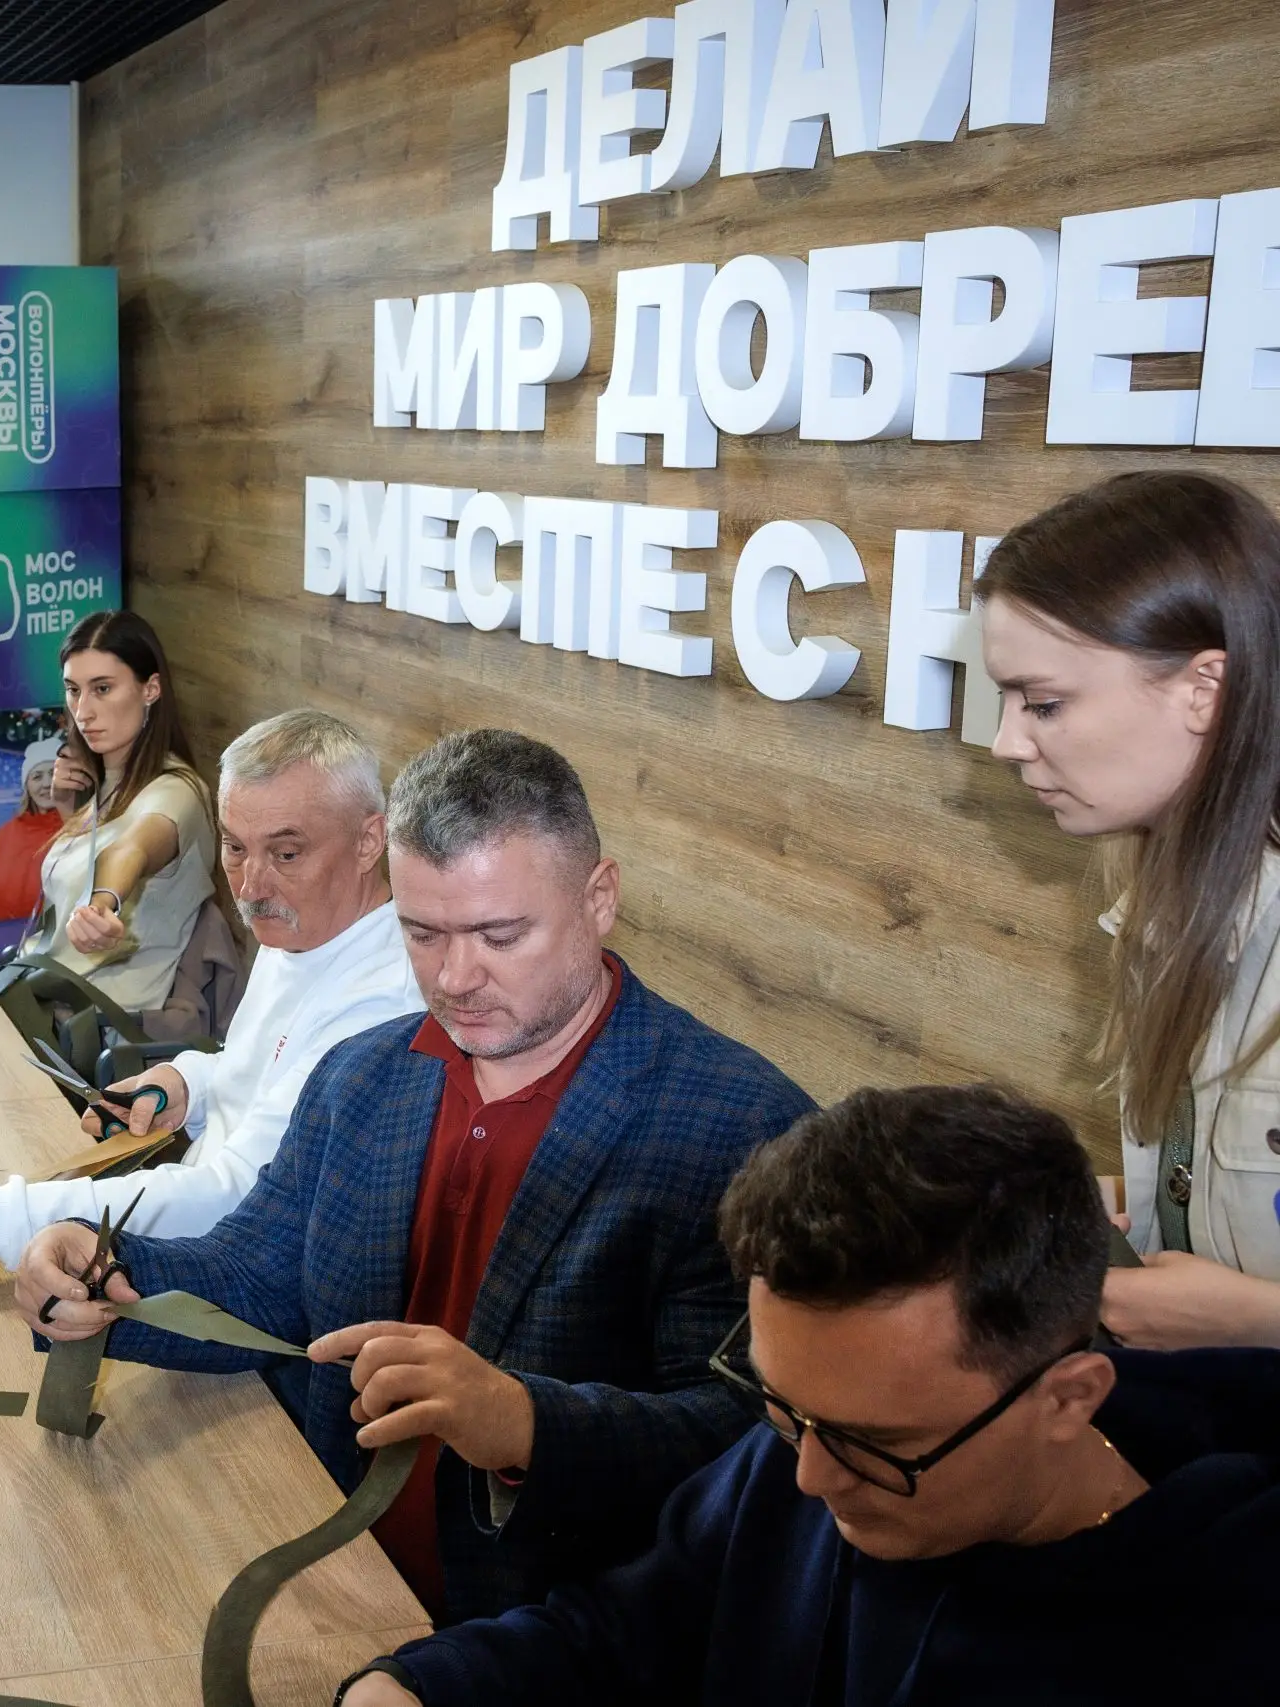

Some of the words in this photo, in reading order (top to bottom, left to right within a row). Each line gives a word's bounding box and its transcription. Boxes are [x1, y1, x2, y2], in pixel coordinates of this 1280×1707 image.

[28, 304, 49, 451] ВОЛОНТЁРЫ
[373, 282, 591, 432] МИР
[25, 550, 76, 576] МОС
[26, 576, 103, 606] ВОЛОН
[304, 475, 718, 678] ВМЕСТЕ
[731, 518, 865, 702] С
[26, 604, 75, 636] ТЁР
